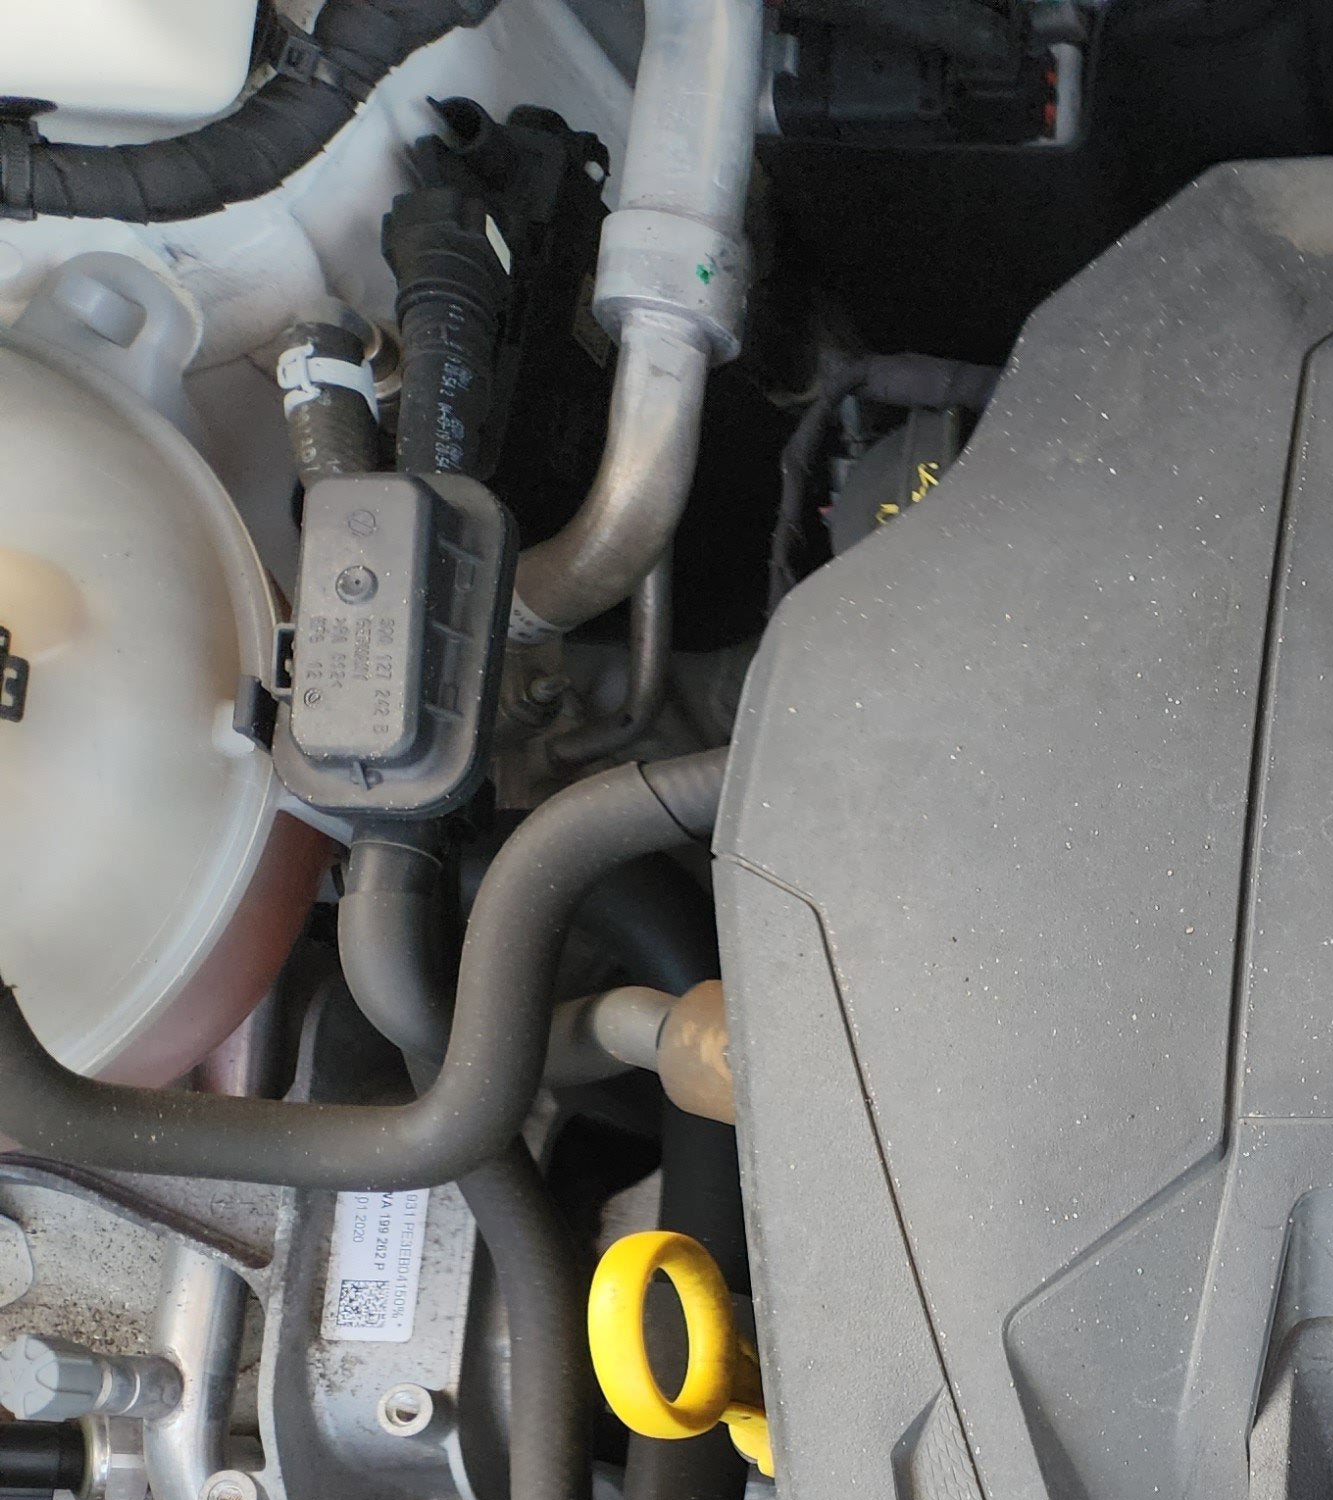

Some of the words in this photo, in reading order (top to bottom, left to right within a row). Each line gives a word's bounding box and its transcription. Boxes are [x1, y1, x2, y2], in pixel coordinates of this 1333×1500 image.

[375, 654, 393, 682] 127
[372, 689, 391, 718] 242
[352, 1214, 368, 1244] 2020
[378, 1213, 391, 1234] 199
[374, 1237, 389, 1260] 262
[374, 1262, 386, 1271] P
